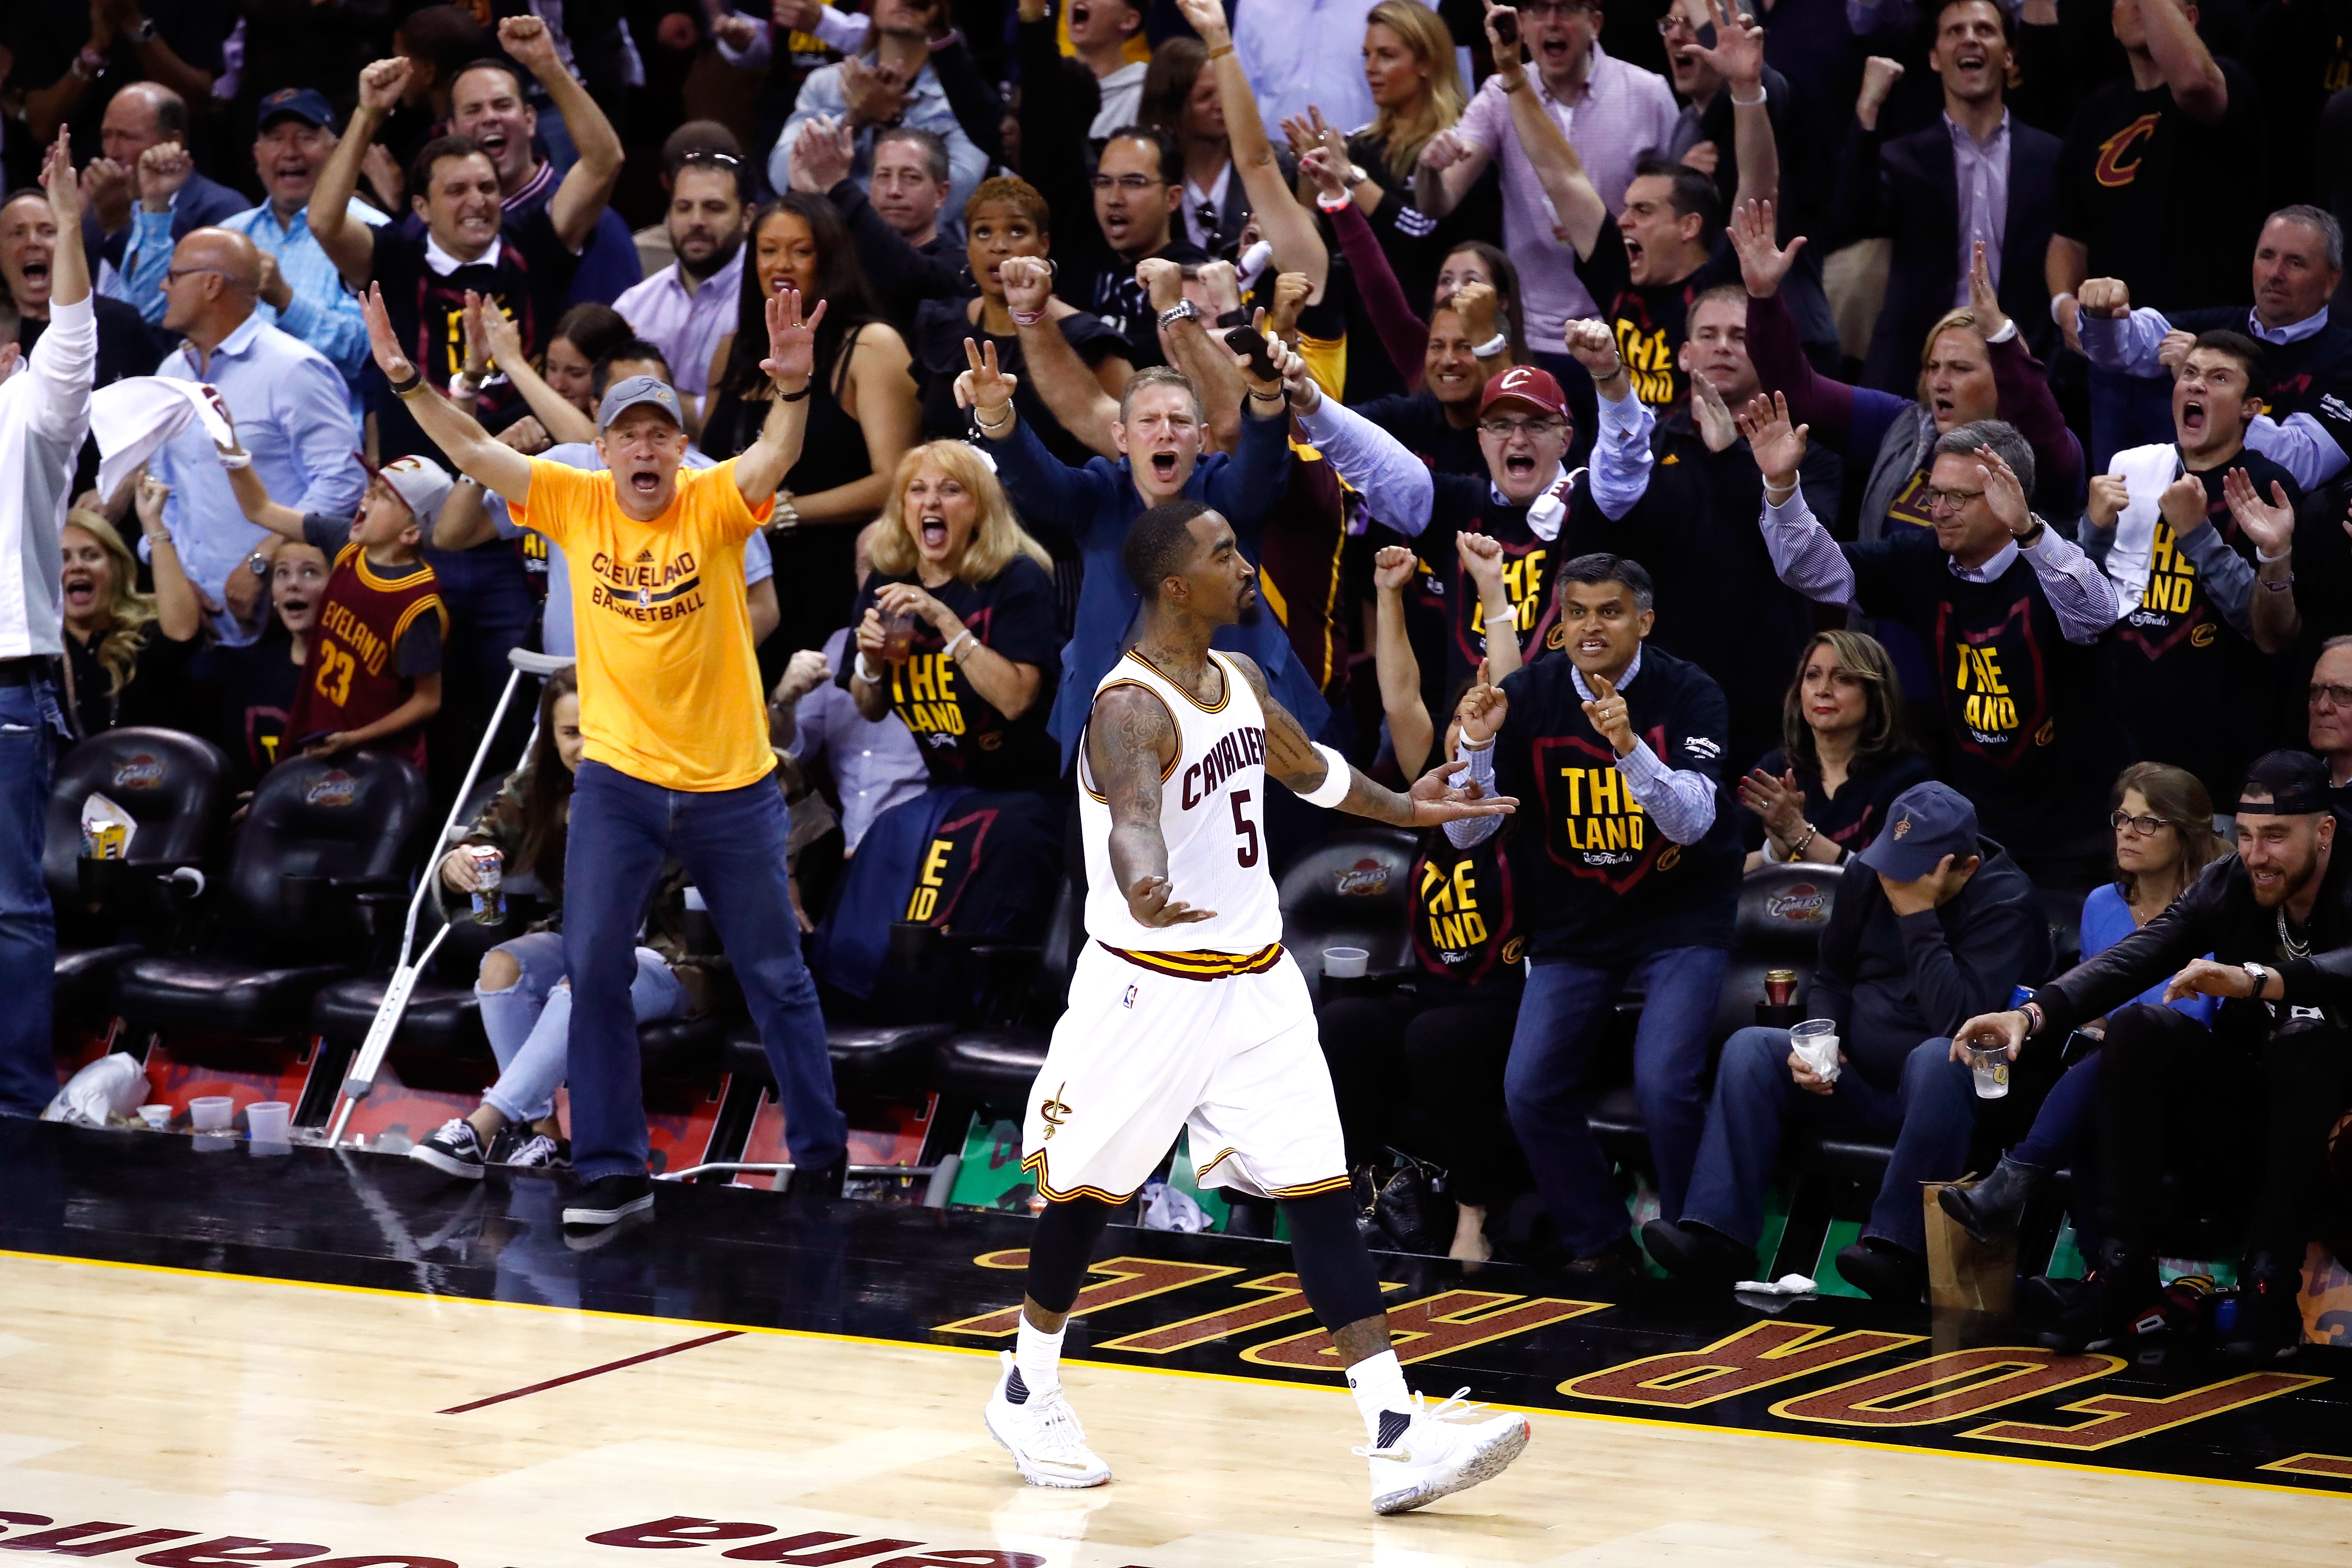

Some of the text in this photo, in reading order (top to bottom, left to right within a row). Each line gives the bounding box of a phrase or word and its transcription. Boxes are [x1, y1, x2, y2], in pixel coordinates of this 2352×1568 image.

[2095, 112, 2161, 187] C
[1616, 317, 1672, 371] THE
[1501, 369, 1532, 389] C
[592, 552, 696, 587] CLEVELAND
[1502, 549, 1546, 601] HE
[321, 600, 388, 676] EVELAND
[315, 639, 355, 708] 23
[890, 653, 957, 704] THE
[1956, 642, 2010, 695] THE
[895, 701, 967, 736] LAND
[1963, 695, 2020, 731] AND
[1181, 726, 1266, 811] CAVALIER
[1230, 789, 1259, 868] 5
[1567, 815, 1644, 851] LAND
[1429, 911, 1488, 950] AND
[1556, 1320, 2334, 1451] FOR
